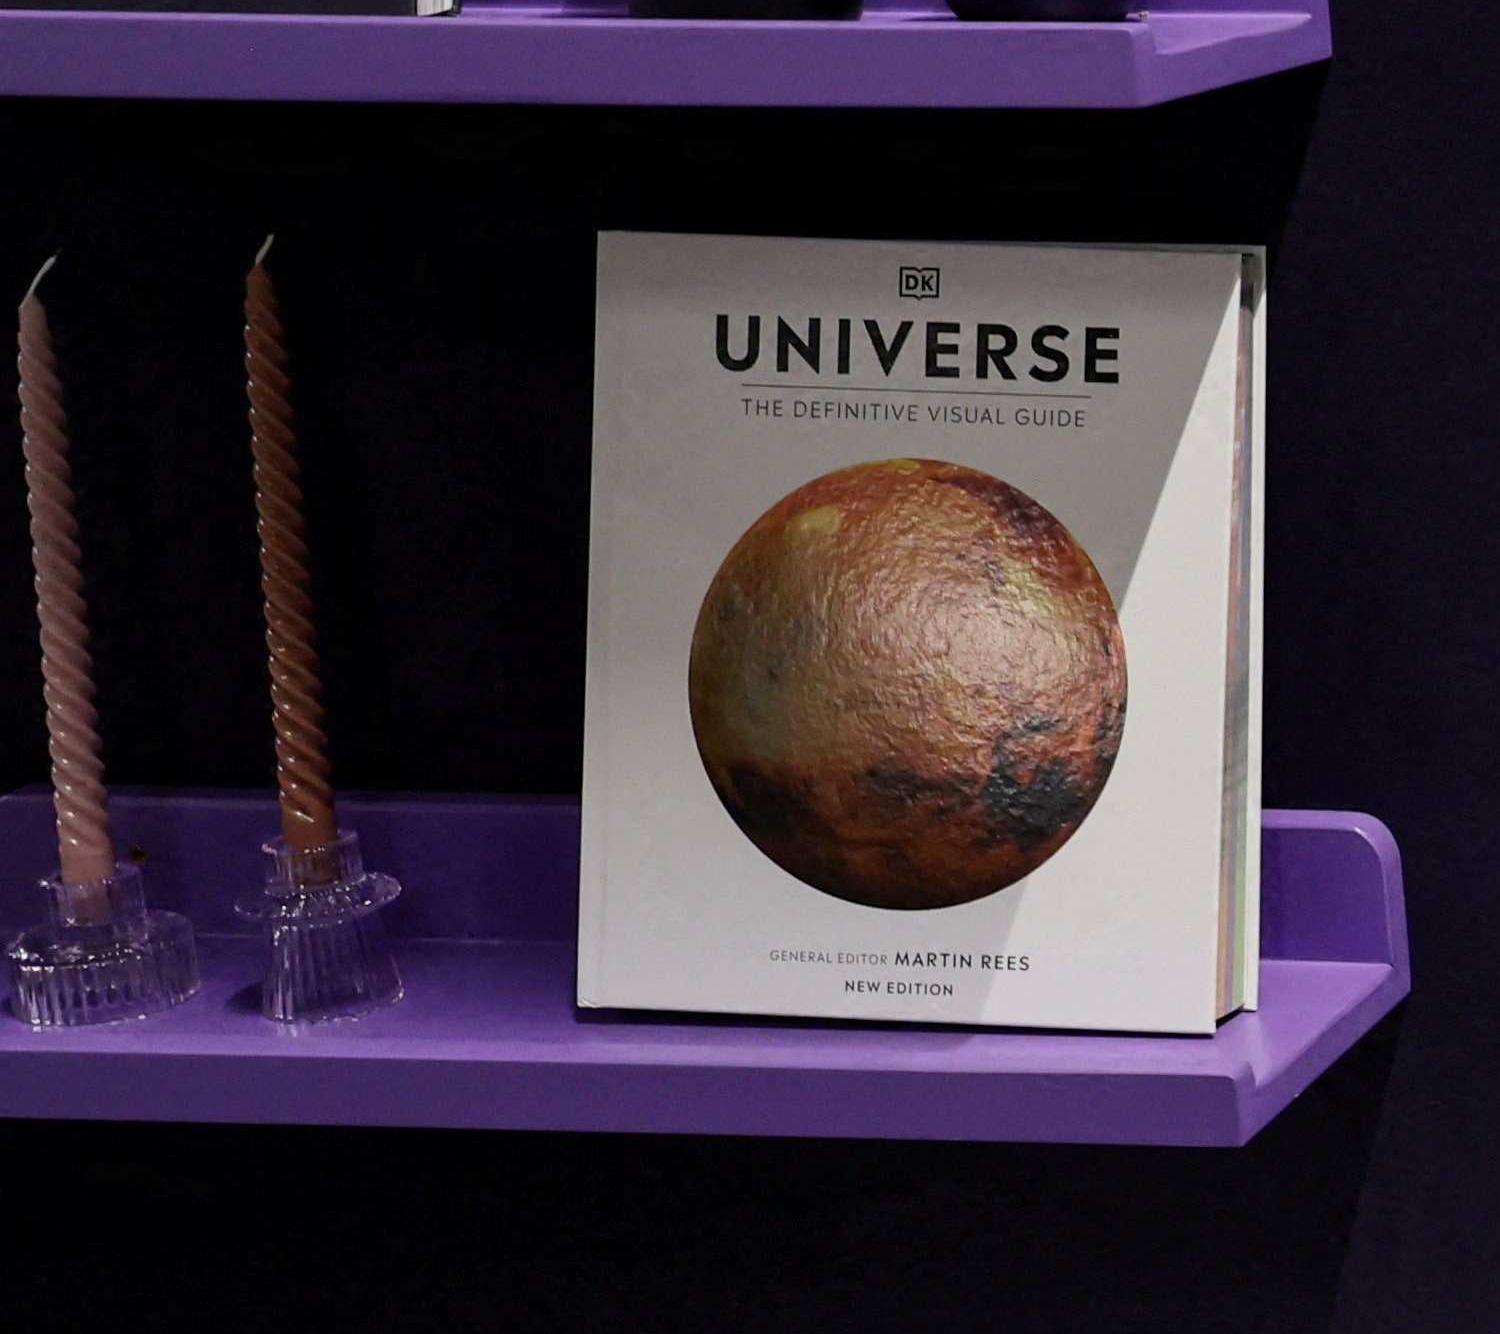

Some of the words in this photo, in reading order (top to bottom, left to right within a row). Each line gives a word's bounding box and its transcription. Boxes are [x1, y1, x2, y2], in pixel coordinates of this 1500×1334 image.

[904, 273, 935, 292] DK
[715, 314, 1120, 384] UNIVERSE
[741, 398, 783, 418] THE
[793, 400, 918, 423] DEFINITIVE
[928, 405, 1005, 425] VISUAL
[1015, 409, 1086, 428] GUIDE
[769, 949, 832, 964] GENERAL
[837, 953, 888, 965] EDITOR
[894, 952, 972, 968] MARTIN
[981, 955, 1030, 971] REES
[845, 980, 880, 994] NEW
[887, 981, 953, 996] EDITION
